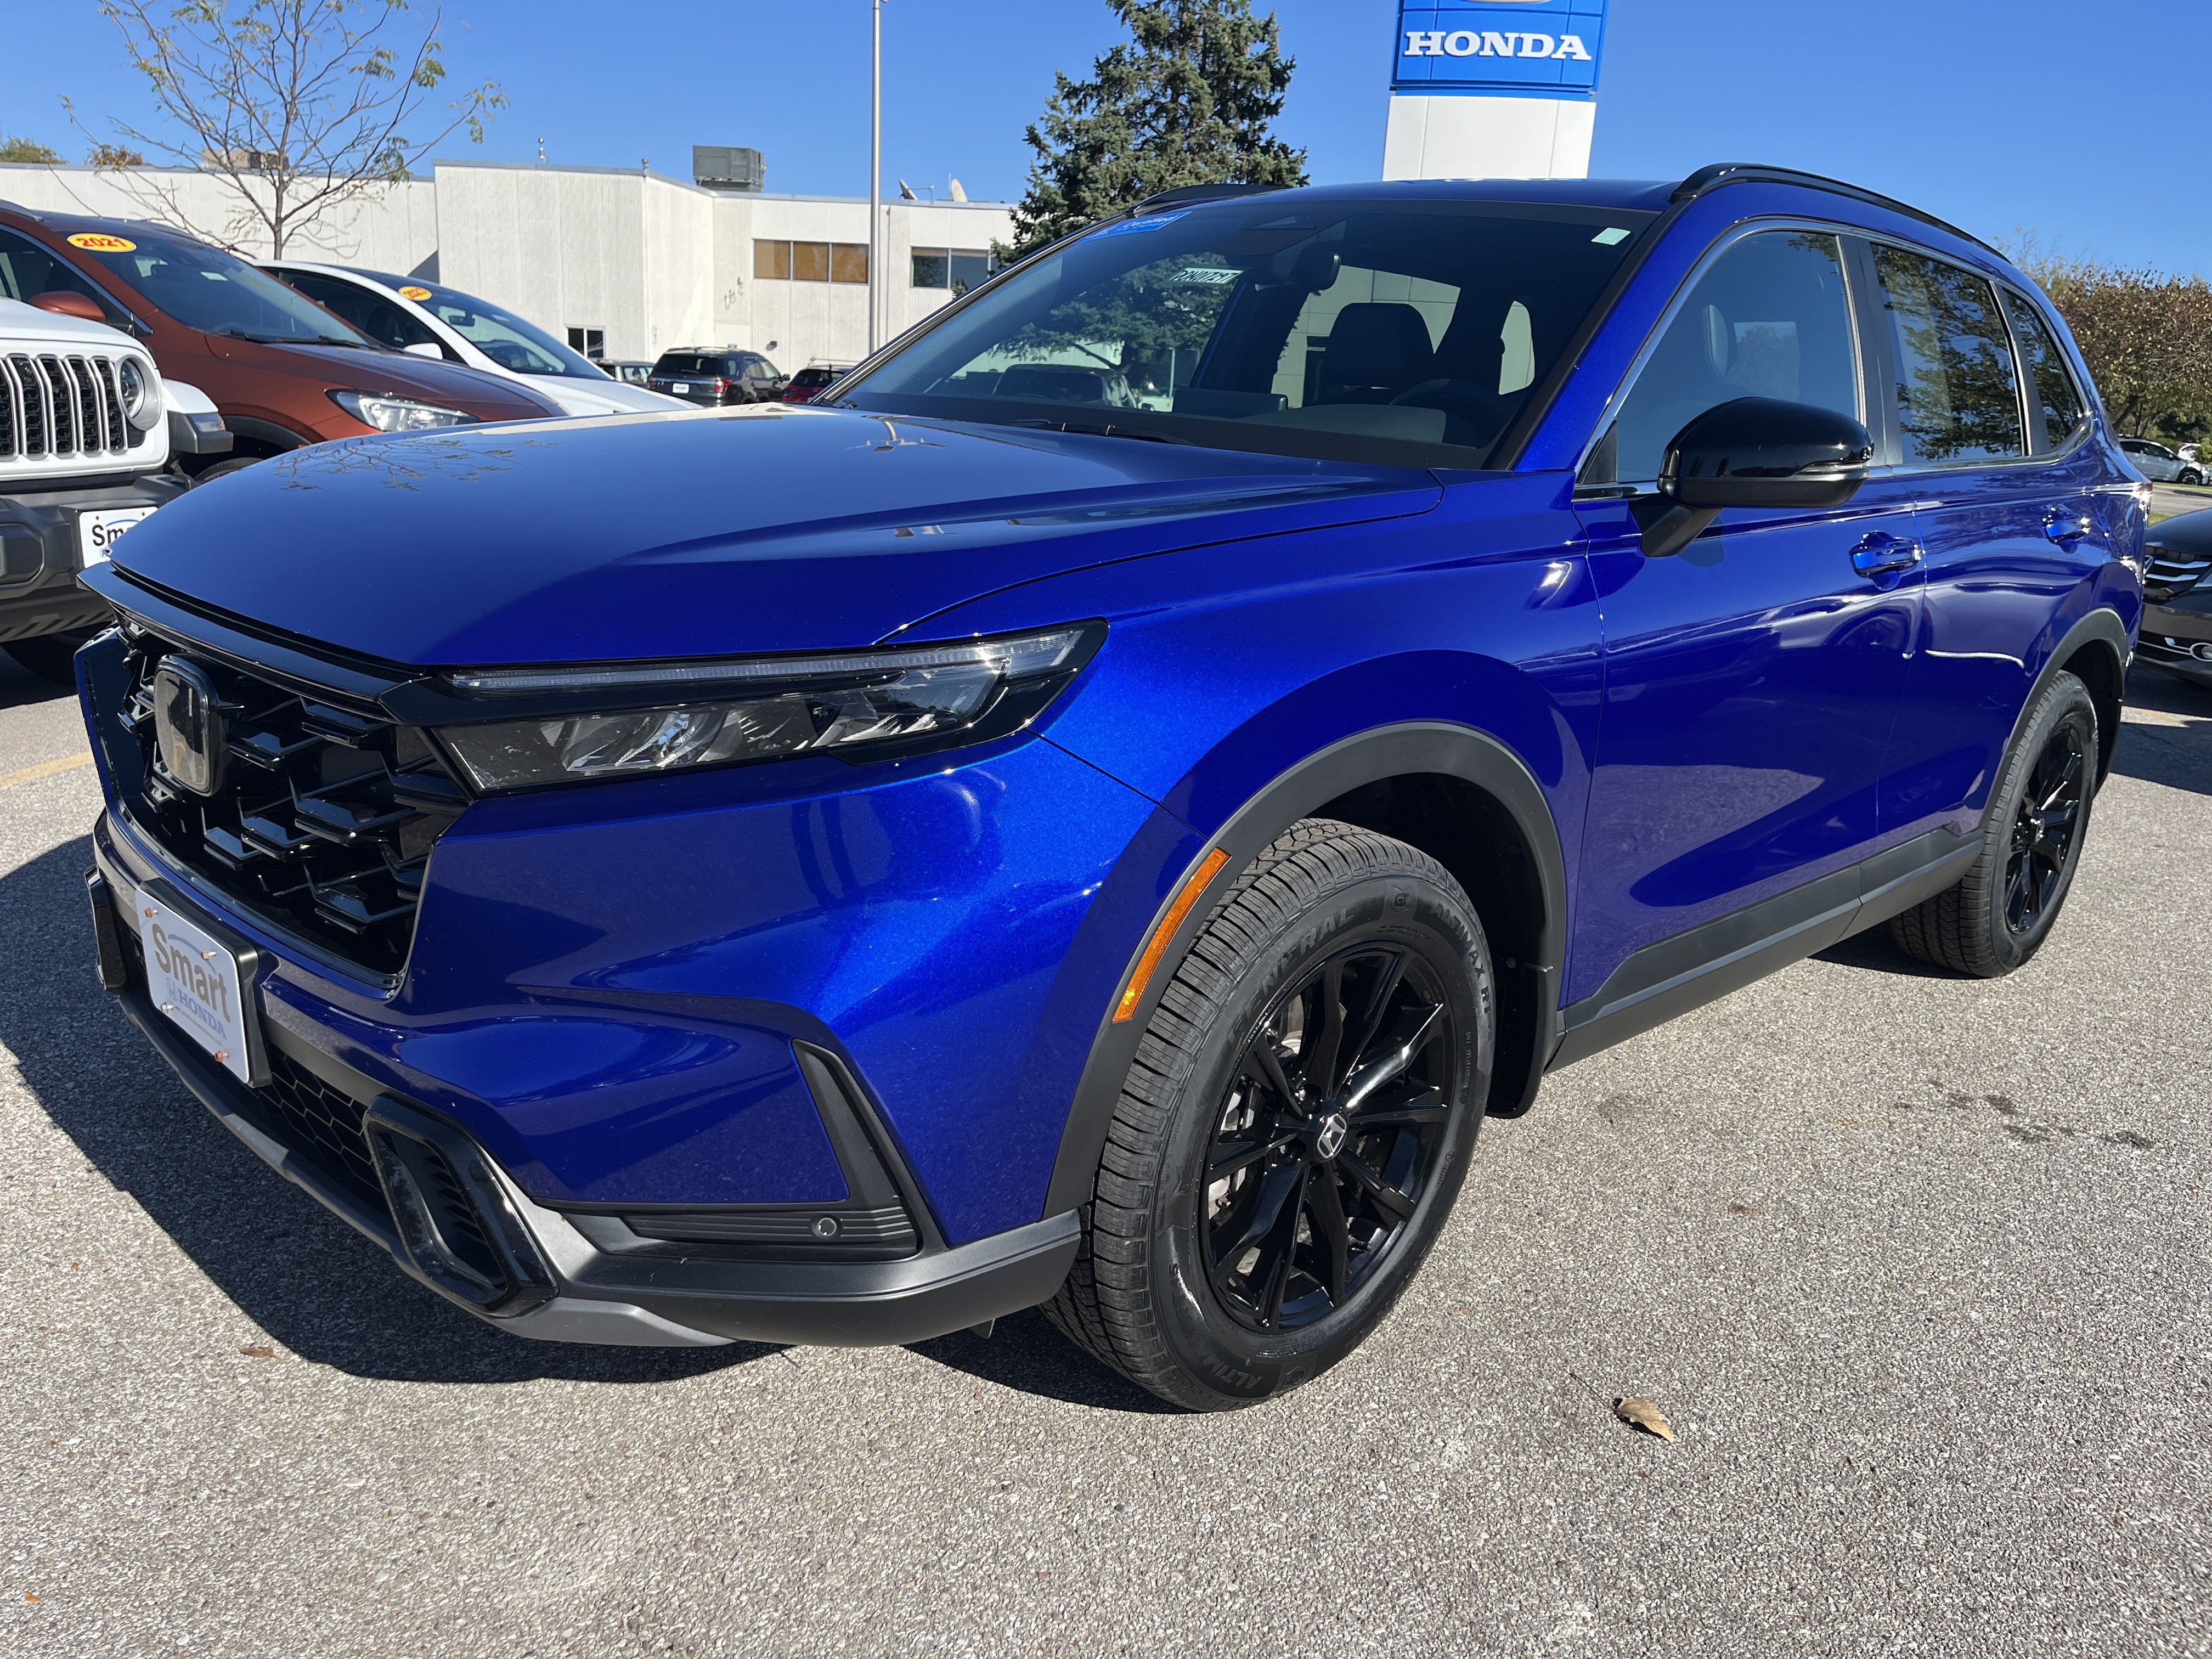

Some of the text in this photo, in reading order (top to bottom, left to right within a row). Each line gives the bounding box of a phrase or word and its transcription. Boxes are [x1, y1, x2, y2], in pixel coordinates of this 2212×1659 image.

[1403, 31, 1592, 61] HONDA
[76, 238, 128, 247] 2021
[92, 524, 132, 546] Sm
[1430, 902, 1486, 980] ALTIMAX
[152, 923, 232, 1024] Smart
[1224, 906, 1356, 1050] GENERAL
[177, 988, 228, 1041] HONDA
